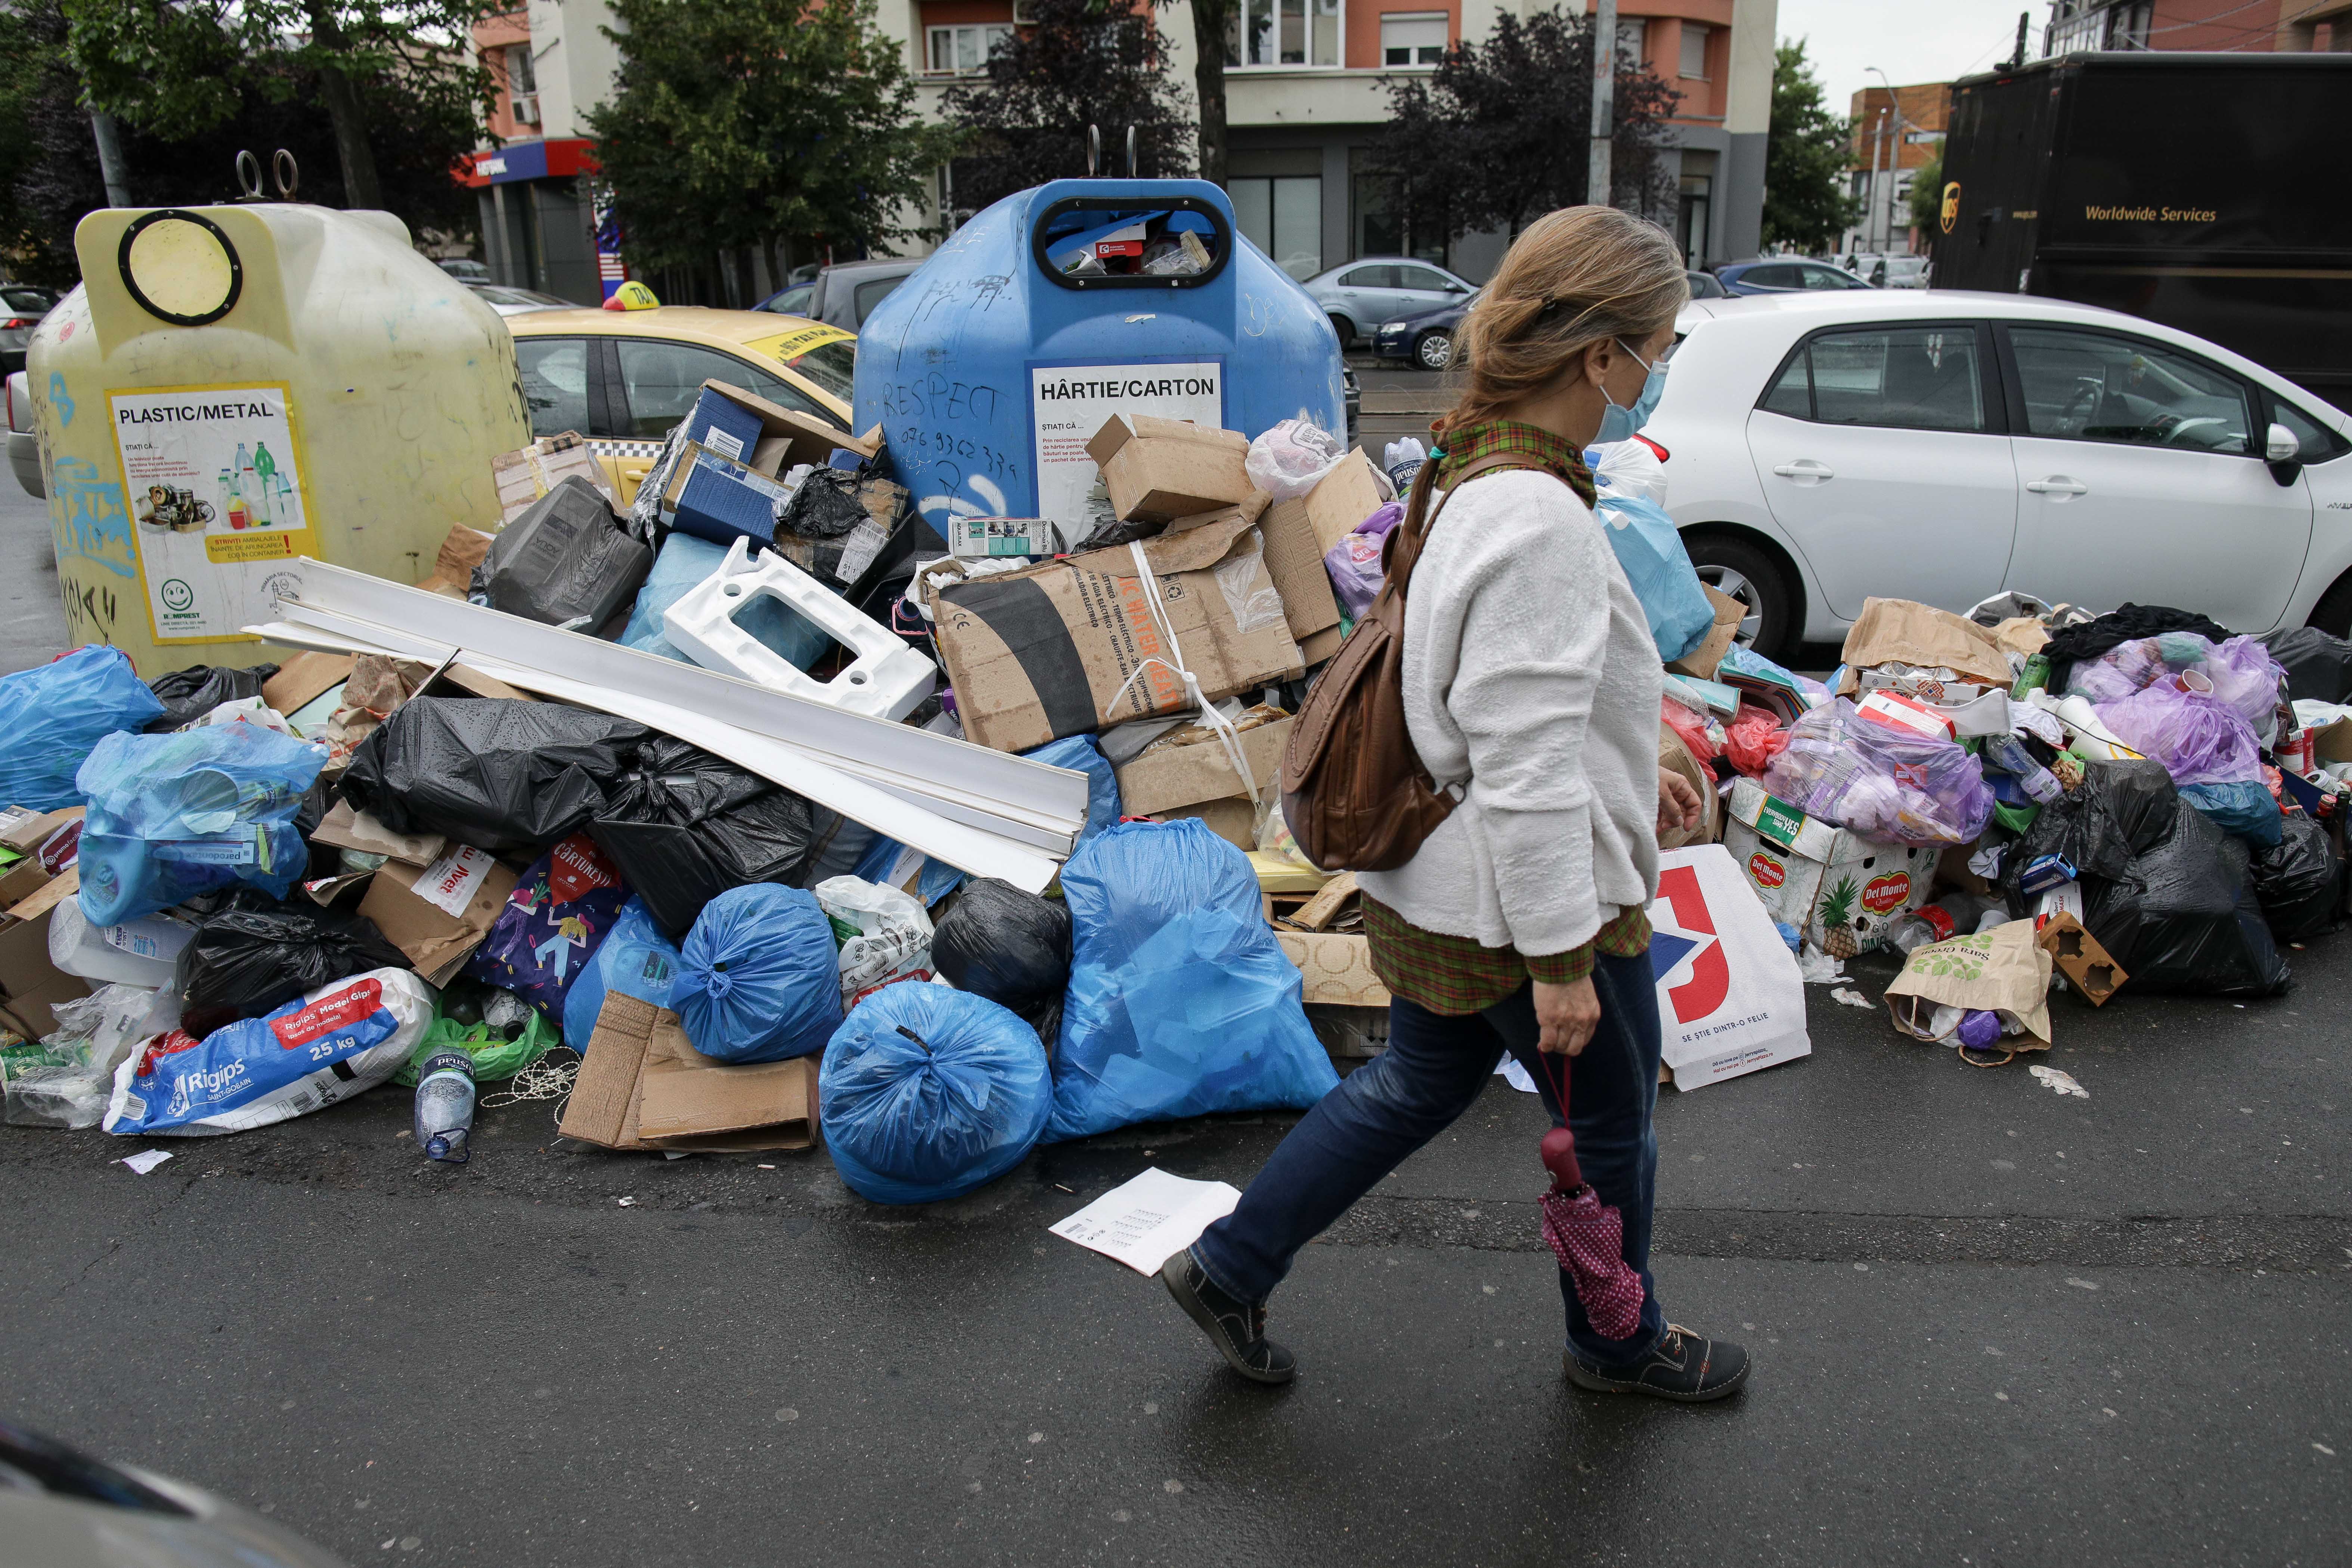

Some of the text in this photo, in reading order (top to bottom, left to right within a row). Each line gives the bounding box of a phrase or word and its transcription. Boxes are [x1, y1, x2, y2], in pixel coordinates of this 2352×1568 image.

[1943, 198, 1957, 226] ups
[2086, 205, 2216, 221] Worldwide Services
[630, 287, 653, 304] TAXI
[883, 371, 1009, 425] RESPECT
[1041, 379, 1214, 400] HÂRTIE/CARTON
[120, 403, 273, 424] PLASTIC/METAL
[537, 537, 559, 554] AQUA
[1084, 598, 1098, 627] ELÉCTRICO
[1091, 582, 1101, 597] AGUA
[1098, 598, 1112, 629] ELÉCTRICO
[1110, 636, 1128, 675] CHAUFFE-EAU
[1112, 604, 1124, 623] TERMO
[1119, 624, 1134, 653] ELÉCTRICO
[1127, 598, 1159, 656] WATER
[1763, 806, 1786, 822] EVERYBODY
[1773, 817, 1800, 835] SAYS YES
[54, 833, 80, 858] promofacile
[1752, 859, 1783, 882] Del Monte
[1758, 871, 1772, 883] Quality
[1865, 883, 1908, 900] Del Monte
[1875, 898, 1894, 907] Quality
[1921, 946, 1990, 961] Sara Green
[285, 989, 371, 1030] Rigips Model Gips
[288, 1030, 304, 1040] Ipsos
[316, 1014, 341, 1029] modelaj
[1695, 1029, 1711, 1040] ȘTIE
[1713, 1020, 1745, 1033] DINTR-O
[1747, 1013, 1769, 1023] FELIE
[309, 1036, 355, 1061] 25 kg
[1747, 1053, 1773, 1064] JerrysPizza.ro
[188, 1059, 245, 1094] Rigips
[207, 1078, 251, 1101] SAINT-GOBAIN
